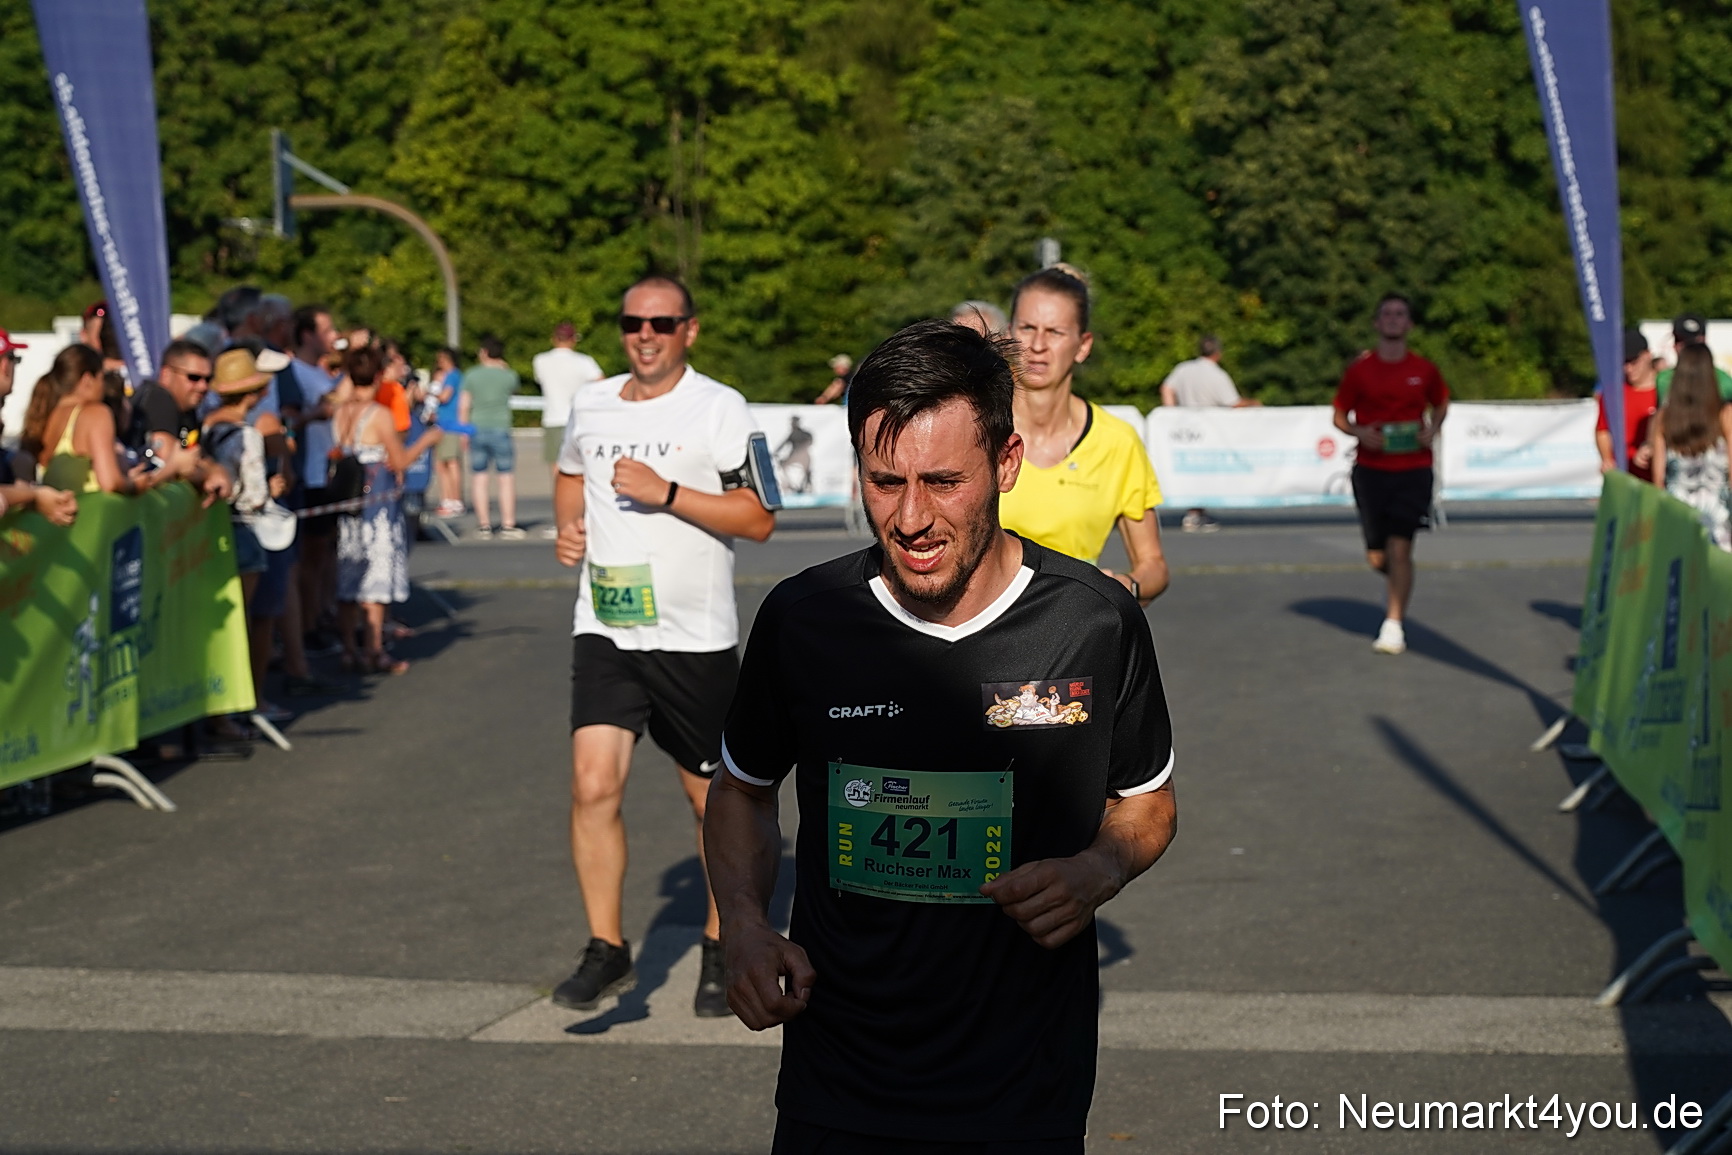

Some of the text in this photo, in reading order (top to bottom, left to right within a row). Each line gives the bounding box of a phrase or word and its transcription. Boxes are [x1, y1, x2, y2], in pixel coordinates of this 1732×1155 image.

[595, 443, 671, 458] APTIV
[828, 704, 887, 720] CRAFT
[873, 793, 931, 804] Firmenlauf
[838, 822, 853, 867] RUN
[870, 815, 958, 860] 421
[984, 825, 1002, 884] 2022
[863, 857, 972, 880] Ruchser Max
